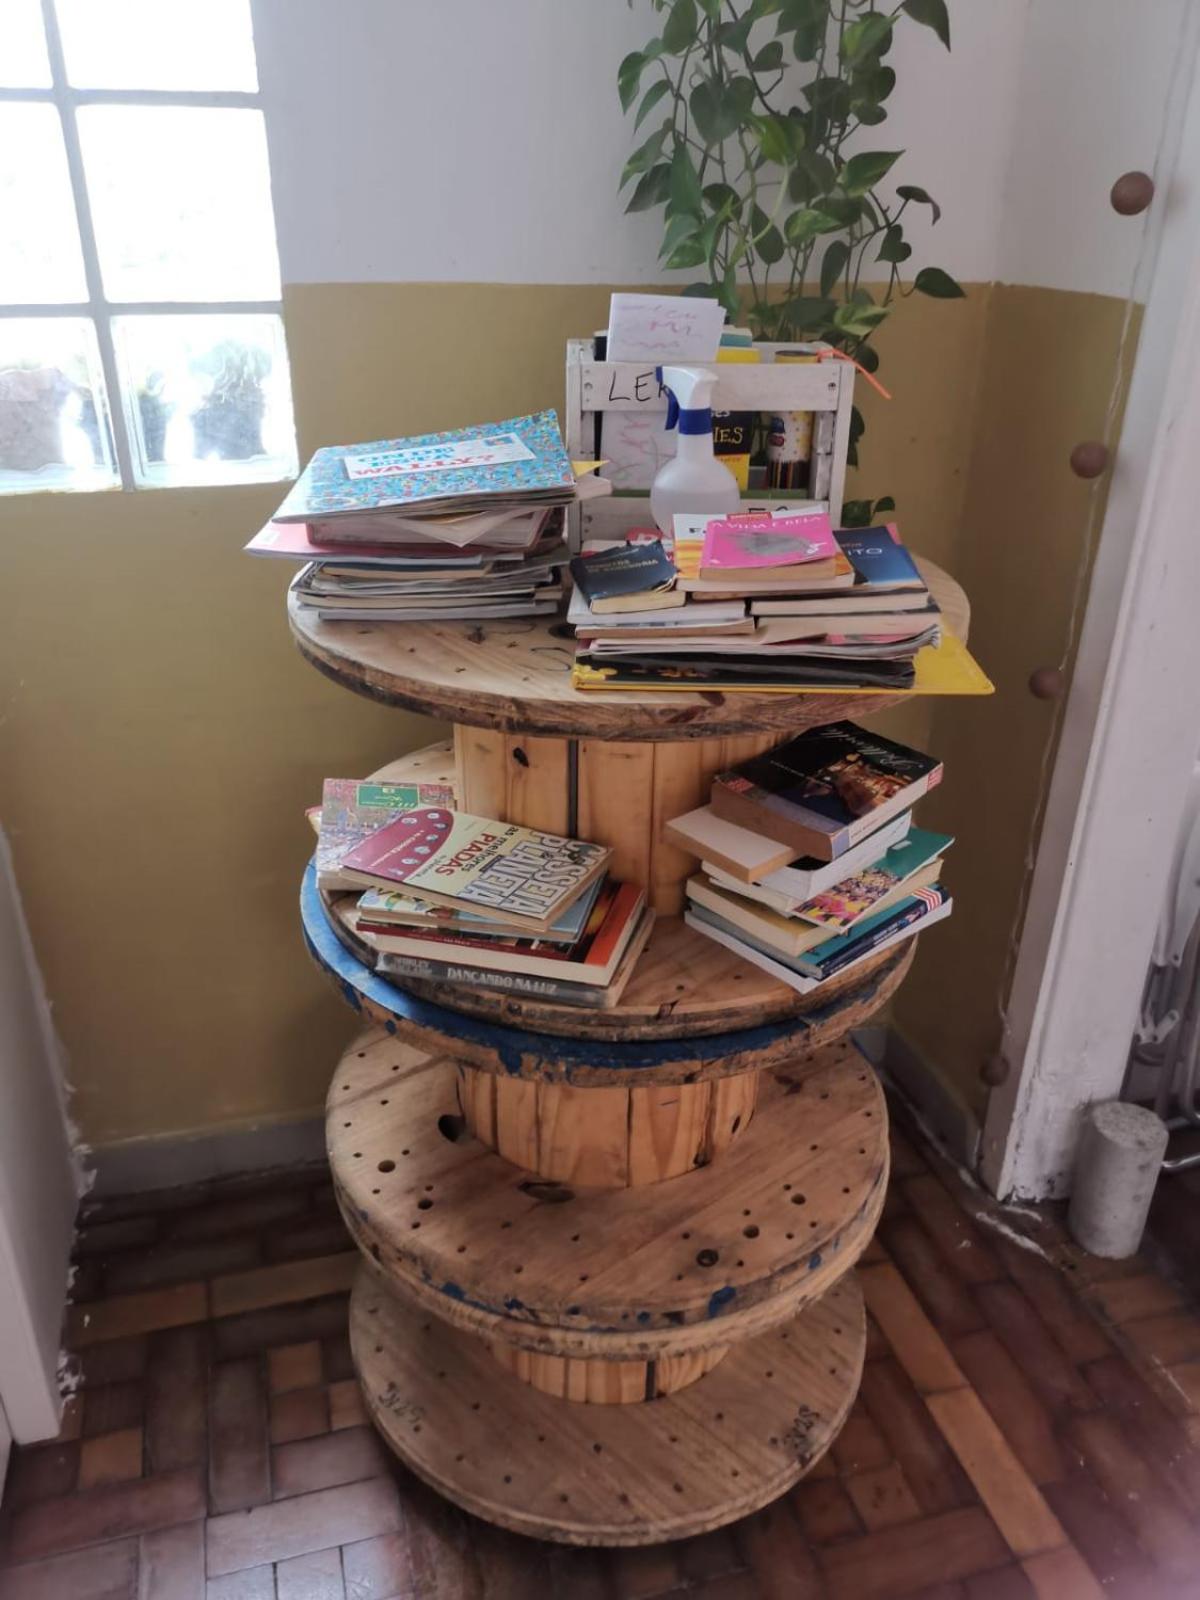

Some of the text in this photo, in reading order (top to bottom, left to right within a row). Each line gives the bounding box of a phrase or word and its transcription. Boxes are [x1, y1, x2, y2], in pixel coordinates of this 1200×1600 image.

[503, 826, 520, 838] as
[434, 832, 495, 877] PIADAS
[455, 830, 568, 906] PLANETA
[460, 836, 509, 873] melhores
[499, 838, 610, 915] CASSETA
[446, 966, 513, 990] DANÇANDO
